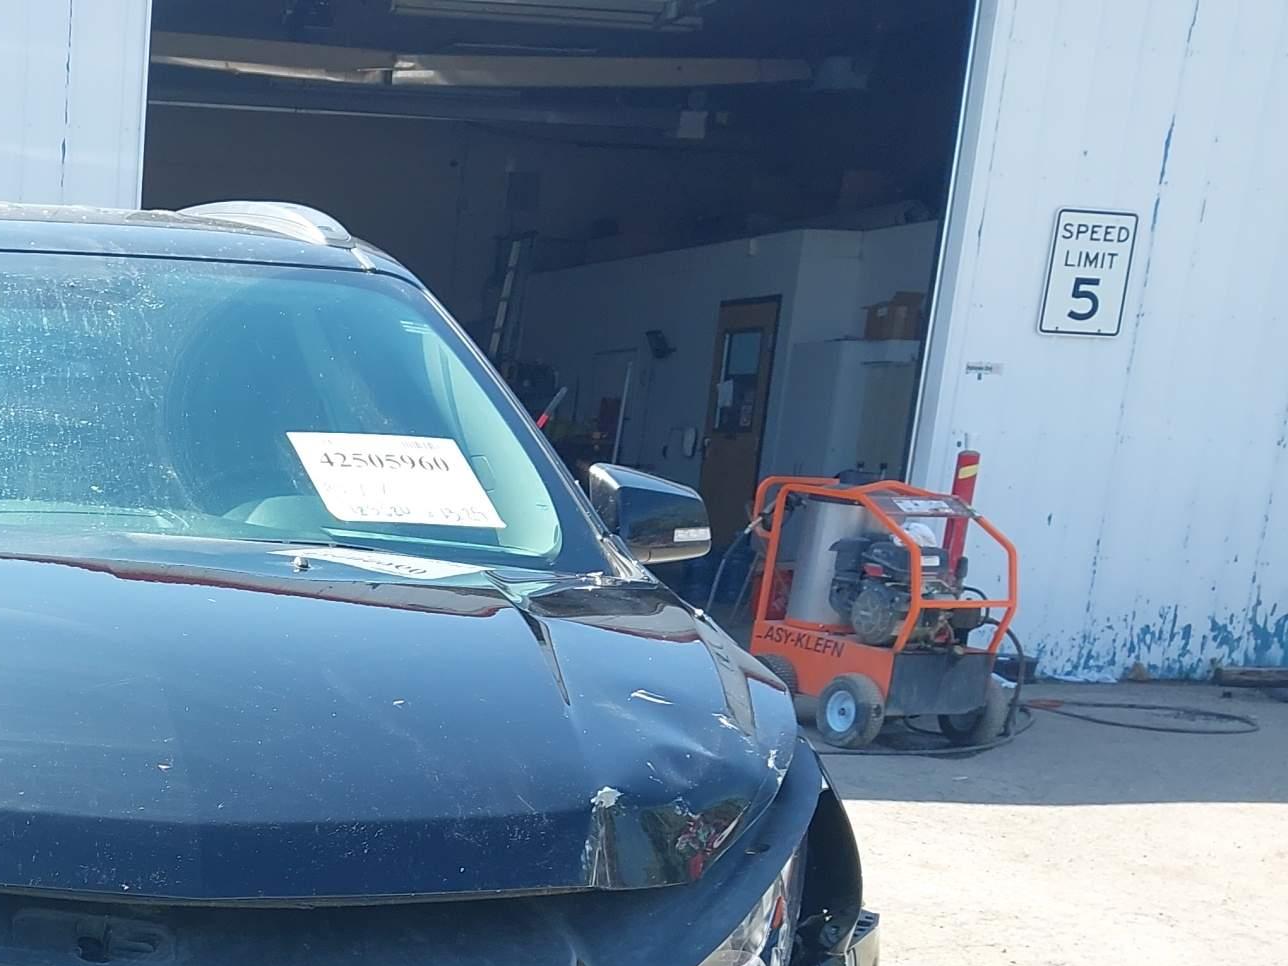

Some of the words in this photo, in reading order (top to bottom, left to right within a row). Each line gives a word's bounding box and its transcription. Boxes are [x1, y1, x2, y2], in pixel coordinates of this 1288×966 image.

[1062, 223, 1130, 243] SPEED
[1064, 250, 1119, 269] LIMIT
[1067, 277, 1101, 321] 5
[320, 452, 450, 472] 42505960
